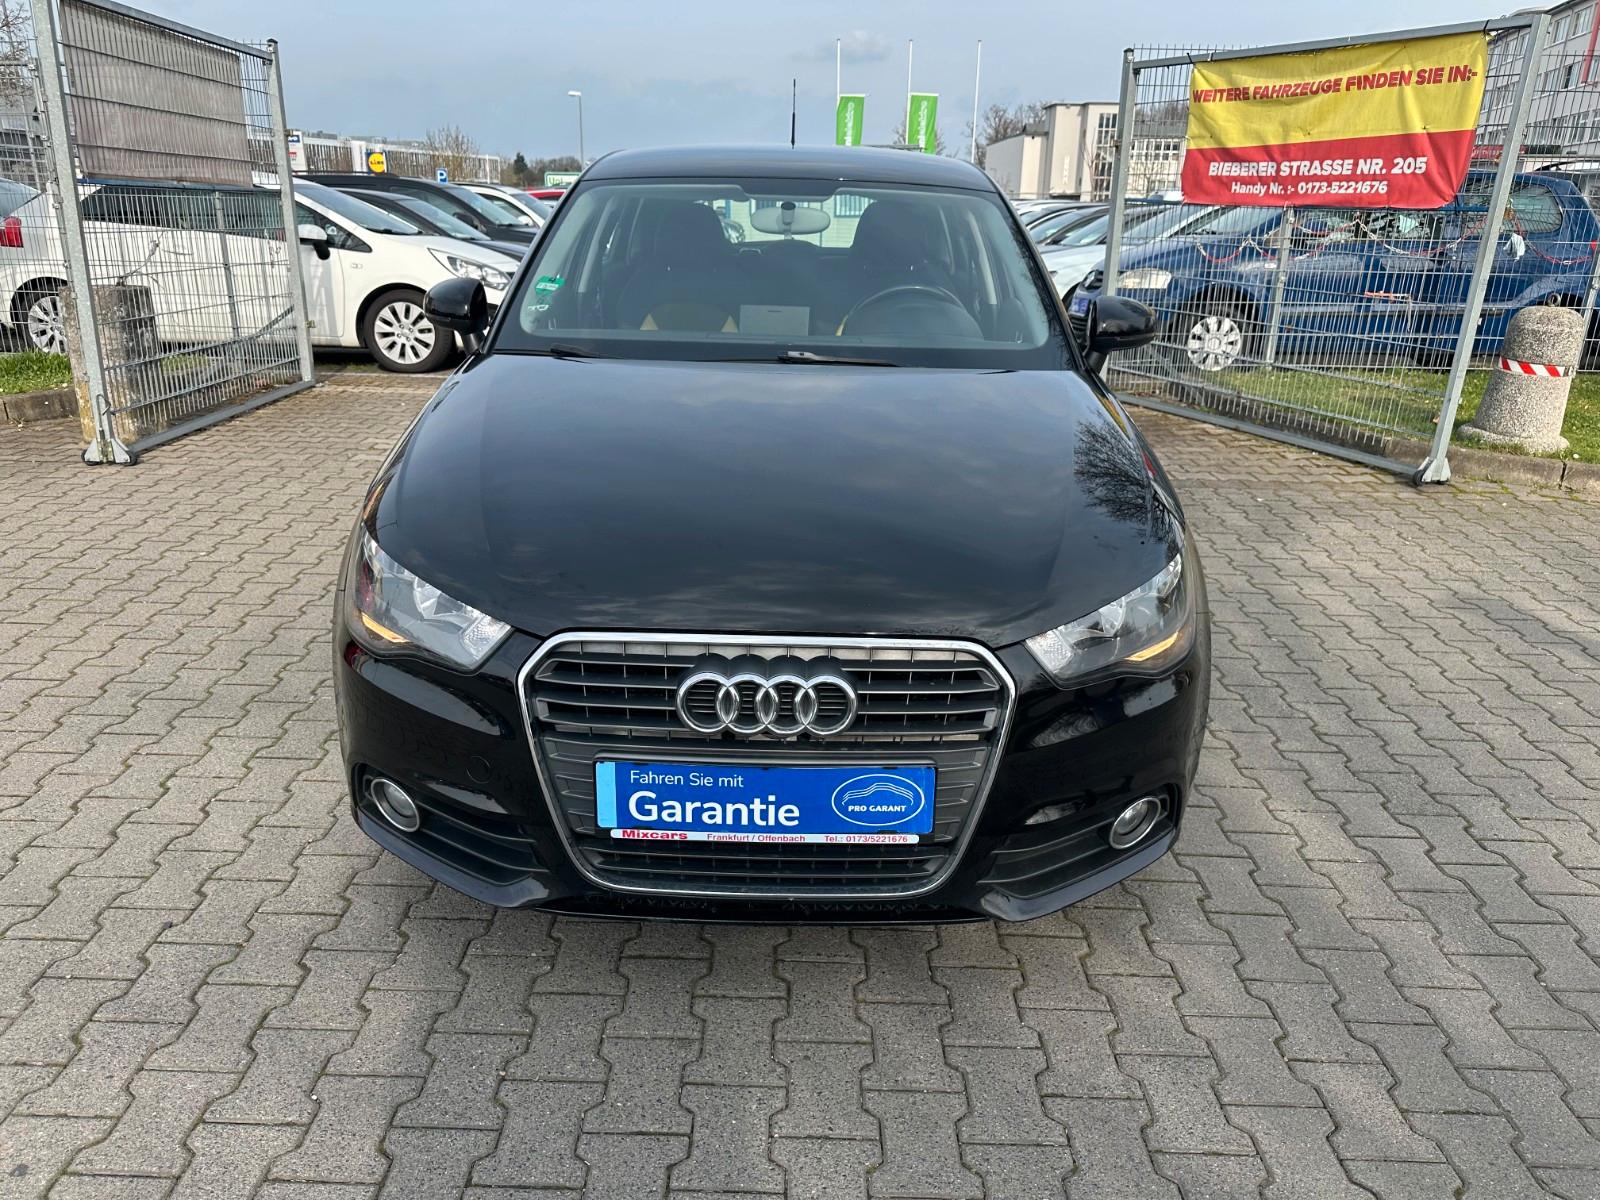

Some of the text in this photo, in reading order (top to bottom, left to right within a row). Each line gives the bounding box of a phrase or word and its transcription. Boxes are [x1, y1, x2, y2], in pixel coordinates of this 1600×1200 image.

[1193, 64, 1478, 103] WEITERE FAHRZEUGE FINDEN SIE IN:-
[1208, 157, 1428, 176] BIEBERER STRASSE NR. 205
[437, 170, 447, 184] P
[1231, 181, 1267, 197] Handy
[1297, 181, 1388, 194] 0173-5221676
[630, 770, 745, 788] Fahren Sie mit
[628, 790, 801, 827] Garantie
[622, 829, 689, 840] Mixcars
[707, 833, 749, 842] Frankfurt
[757, 834, 806, 842] Offenbach
[846, 835, 909, 843] 0173/5221676
